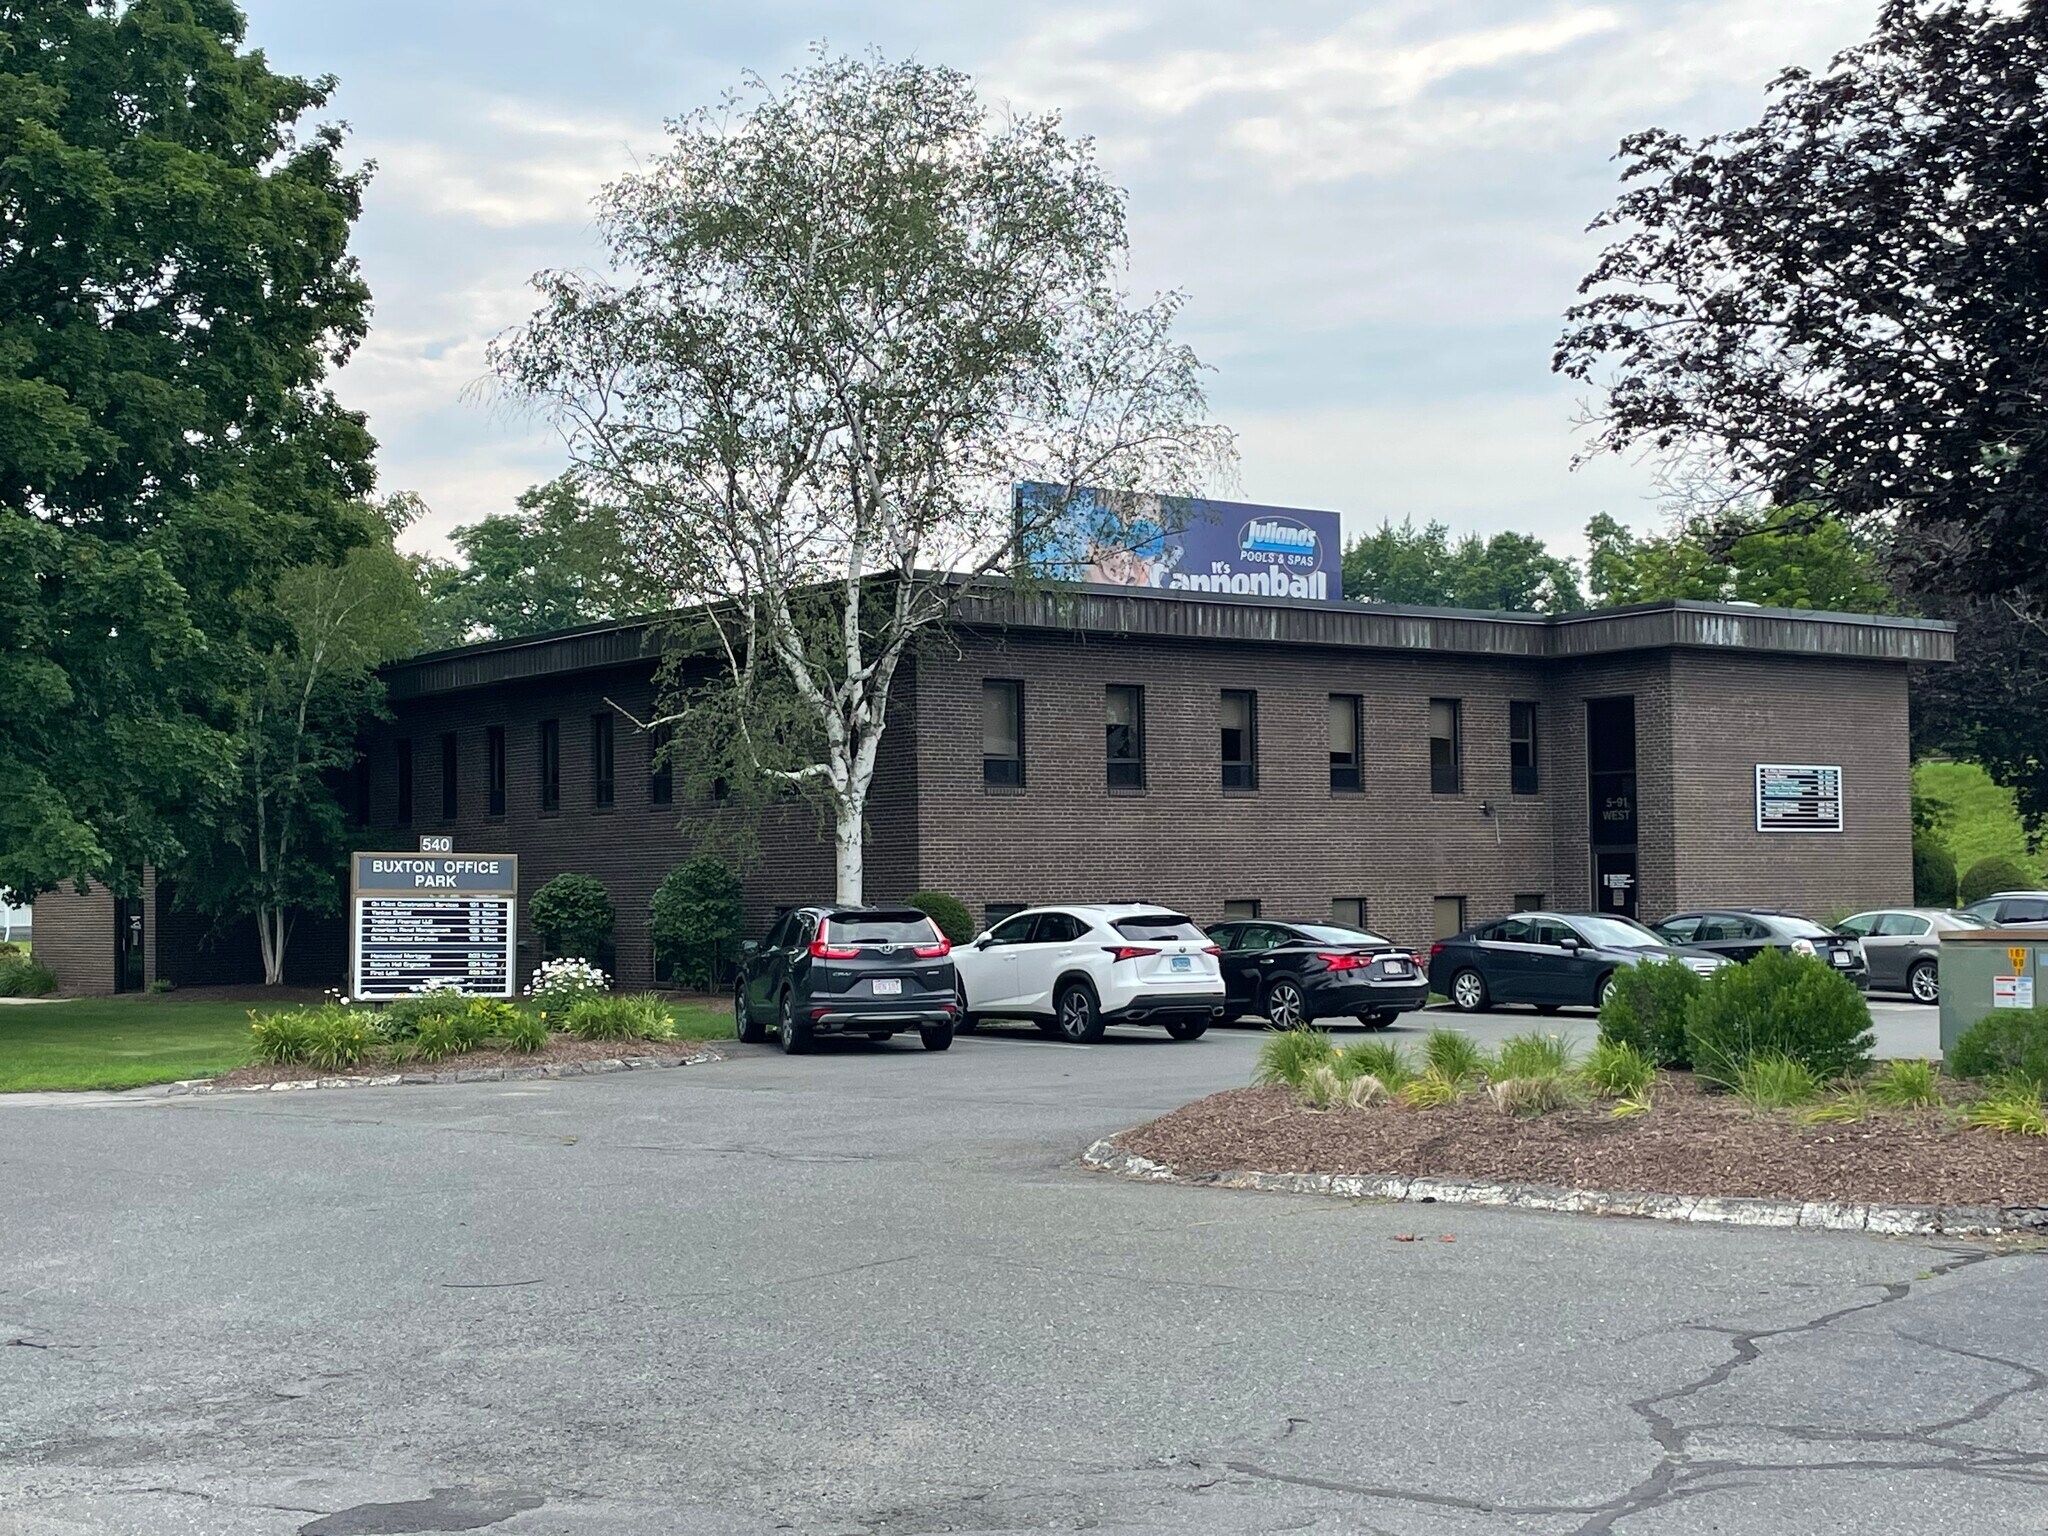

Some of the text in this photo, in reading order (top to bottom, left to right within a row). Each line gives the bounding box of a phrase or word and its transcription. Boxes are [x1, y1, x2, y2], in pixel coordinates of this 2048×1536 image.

[1240, 550, 1314, 567] POOLS & SPAS
[1211, 561, 1231, 574] It's
[1602, 810, 1631, 820] WEST
[422, 838, 450, 851] 540
[372, 860, 499, 874] BUXTON OFFICE
[414, 875, 457, 887] PARK
